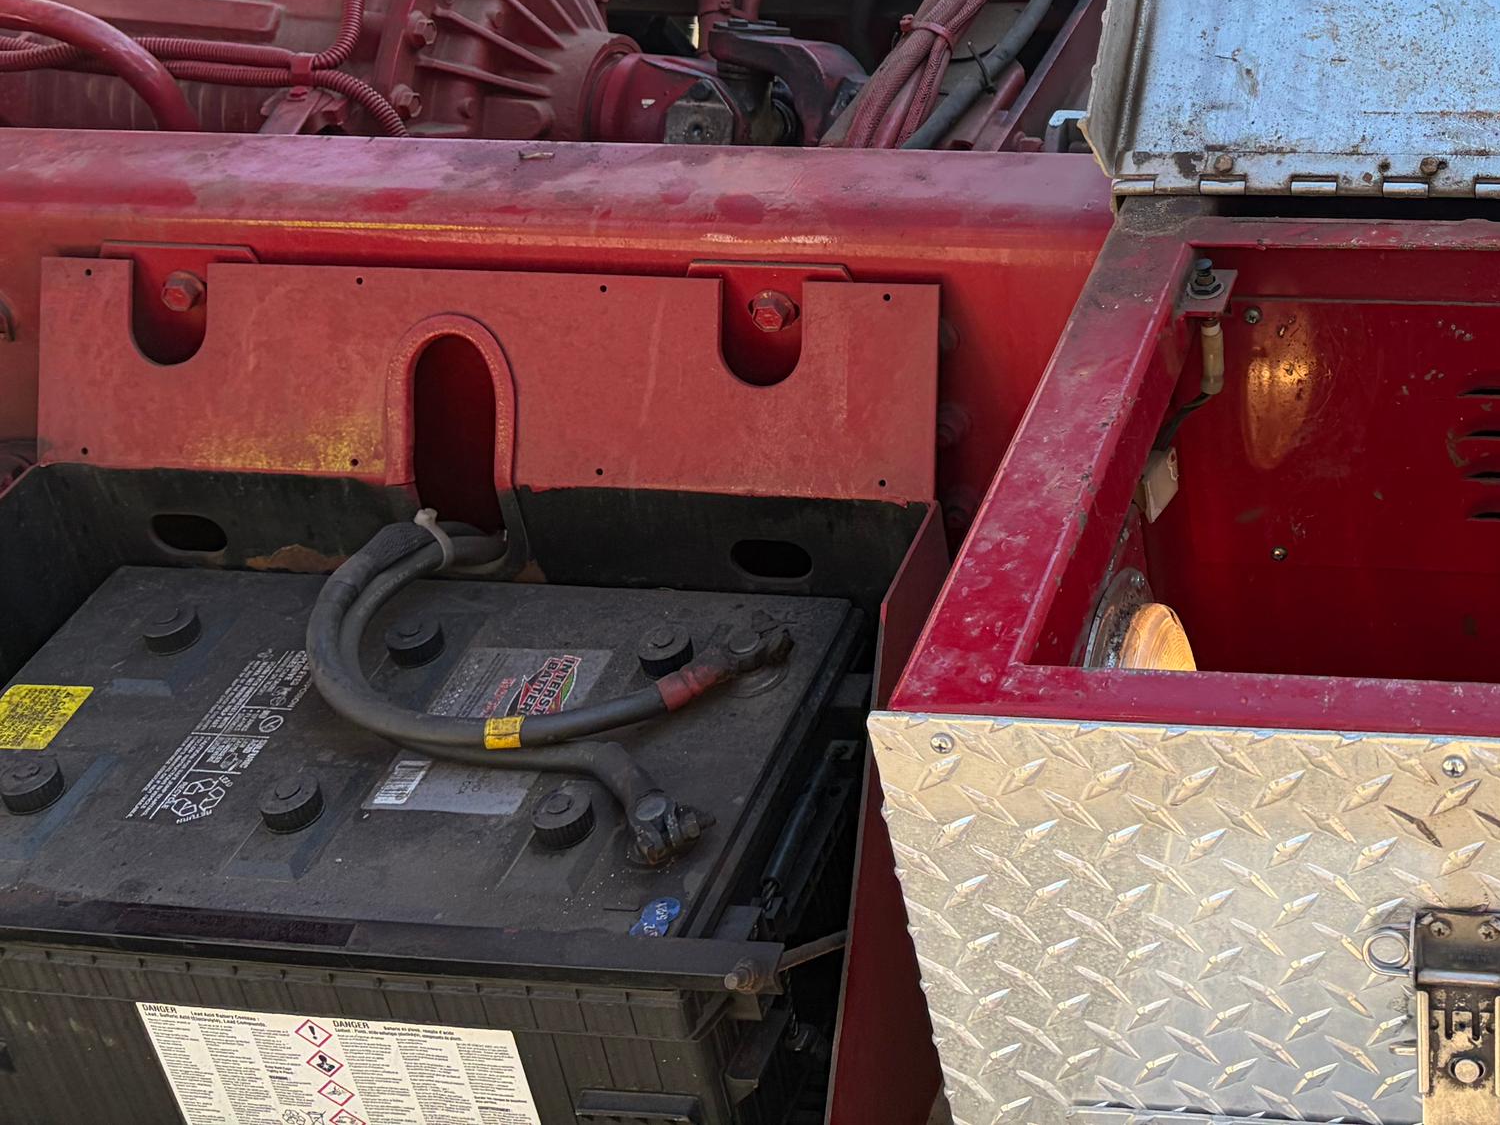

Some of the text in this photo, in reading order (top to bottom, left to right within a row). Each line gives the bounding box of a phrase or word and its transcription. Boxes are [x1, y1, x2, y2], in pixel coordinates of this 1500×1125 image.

[519, 662, 559, 715] BATTER
[533, 658, 575, 715] INTERST
[142, 1004, 177, 1014] DANGER
[332, 1020, 370, 1029] DANGER
